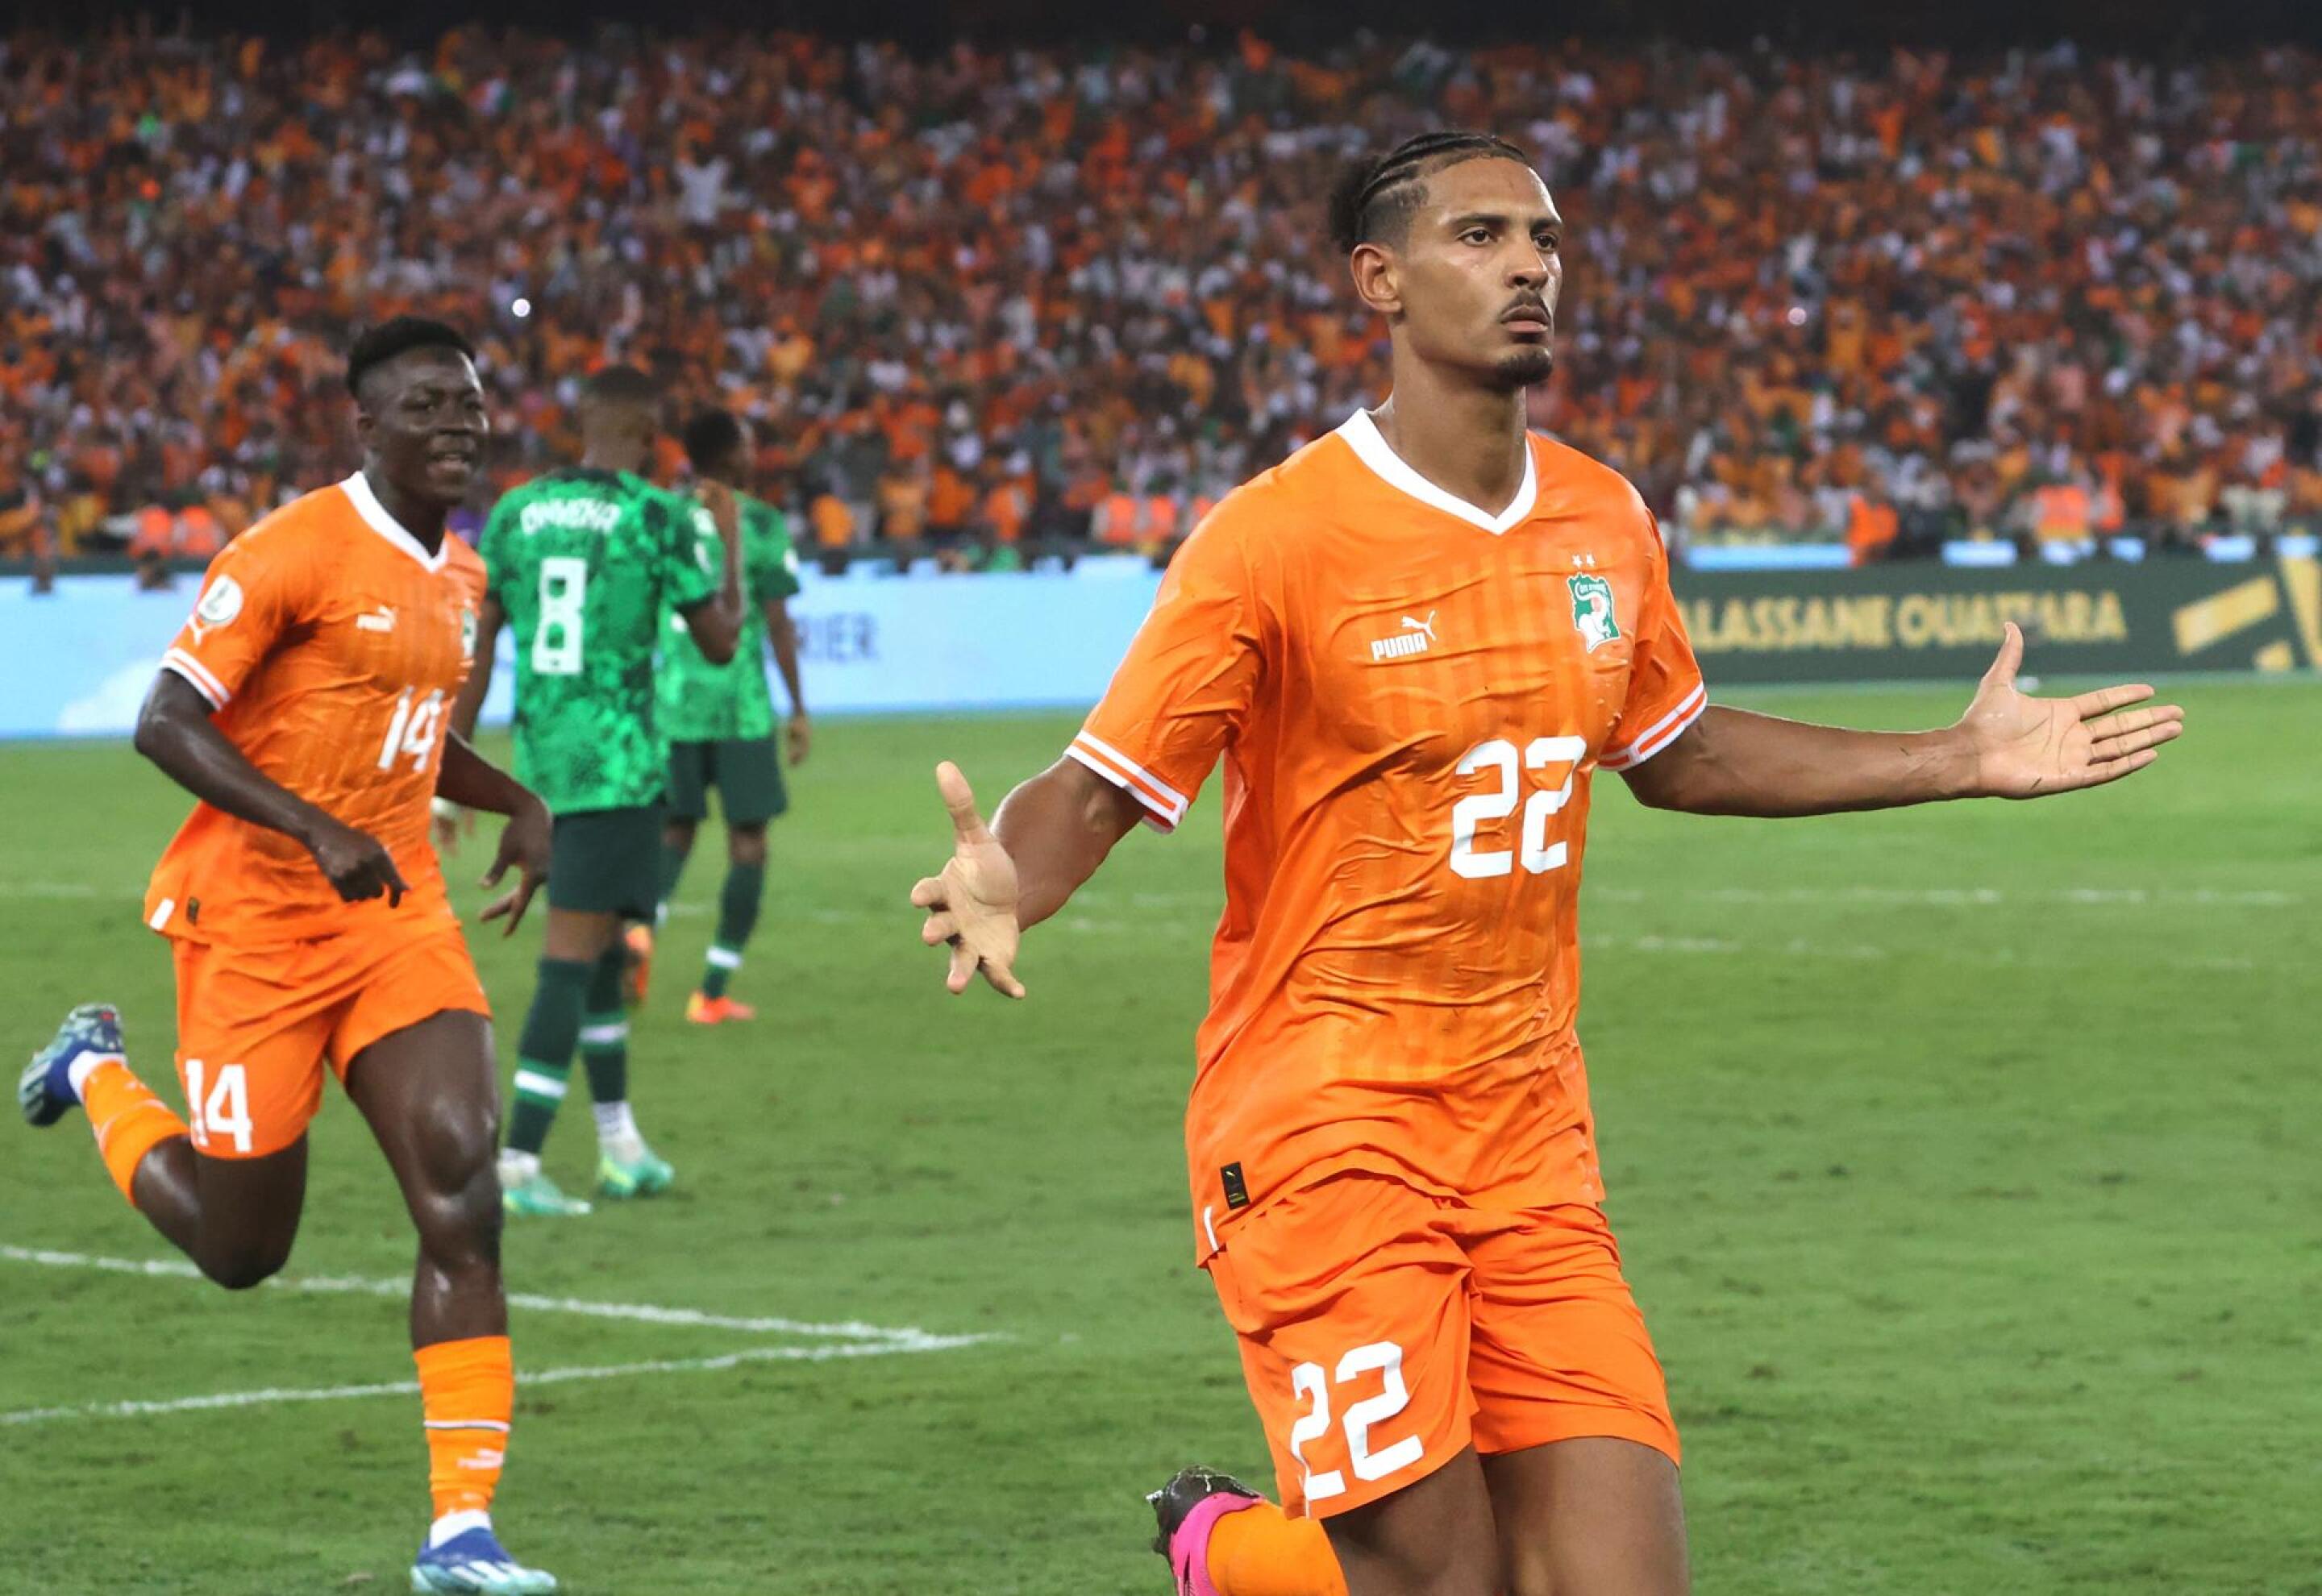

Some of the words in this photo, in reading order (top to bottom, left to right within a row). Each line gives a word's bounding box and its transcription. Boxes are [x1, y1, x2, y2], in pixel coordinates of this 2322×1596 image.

[531, 557, 586, 673] 8
[1371, 632, 1428, 660] PUMA
[378, 685, 445, 773] 14
[1450, 735, 1587, 879] 22
[185, 1059, 253, 1153] 14
[1291, 1340, 1424, 1502] 22
